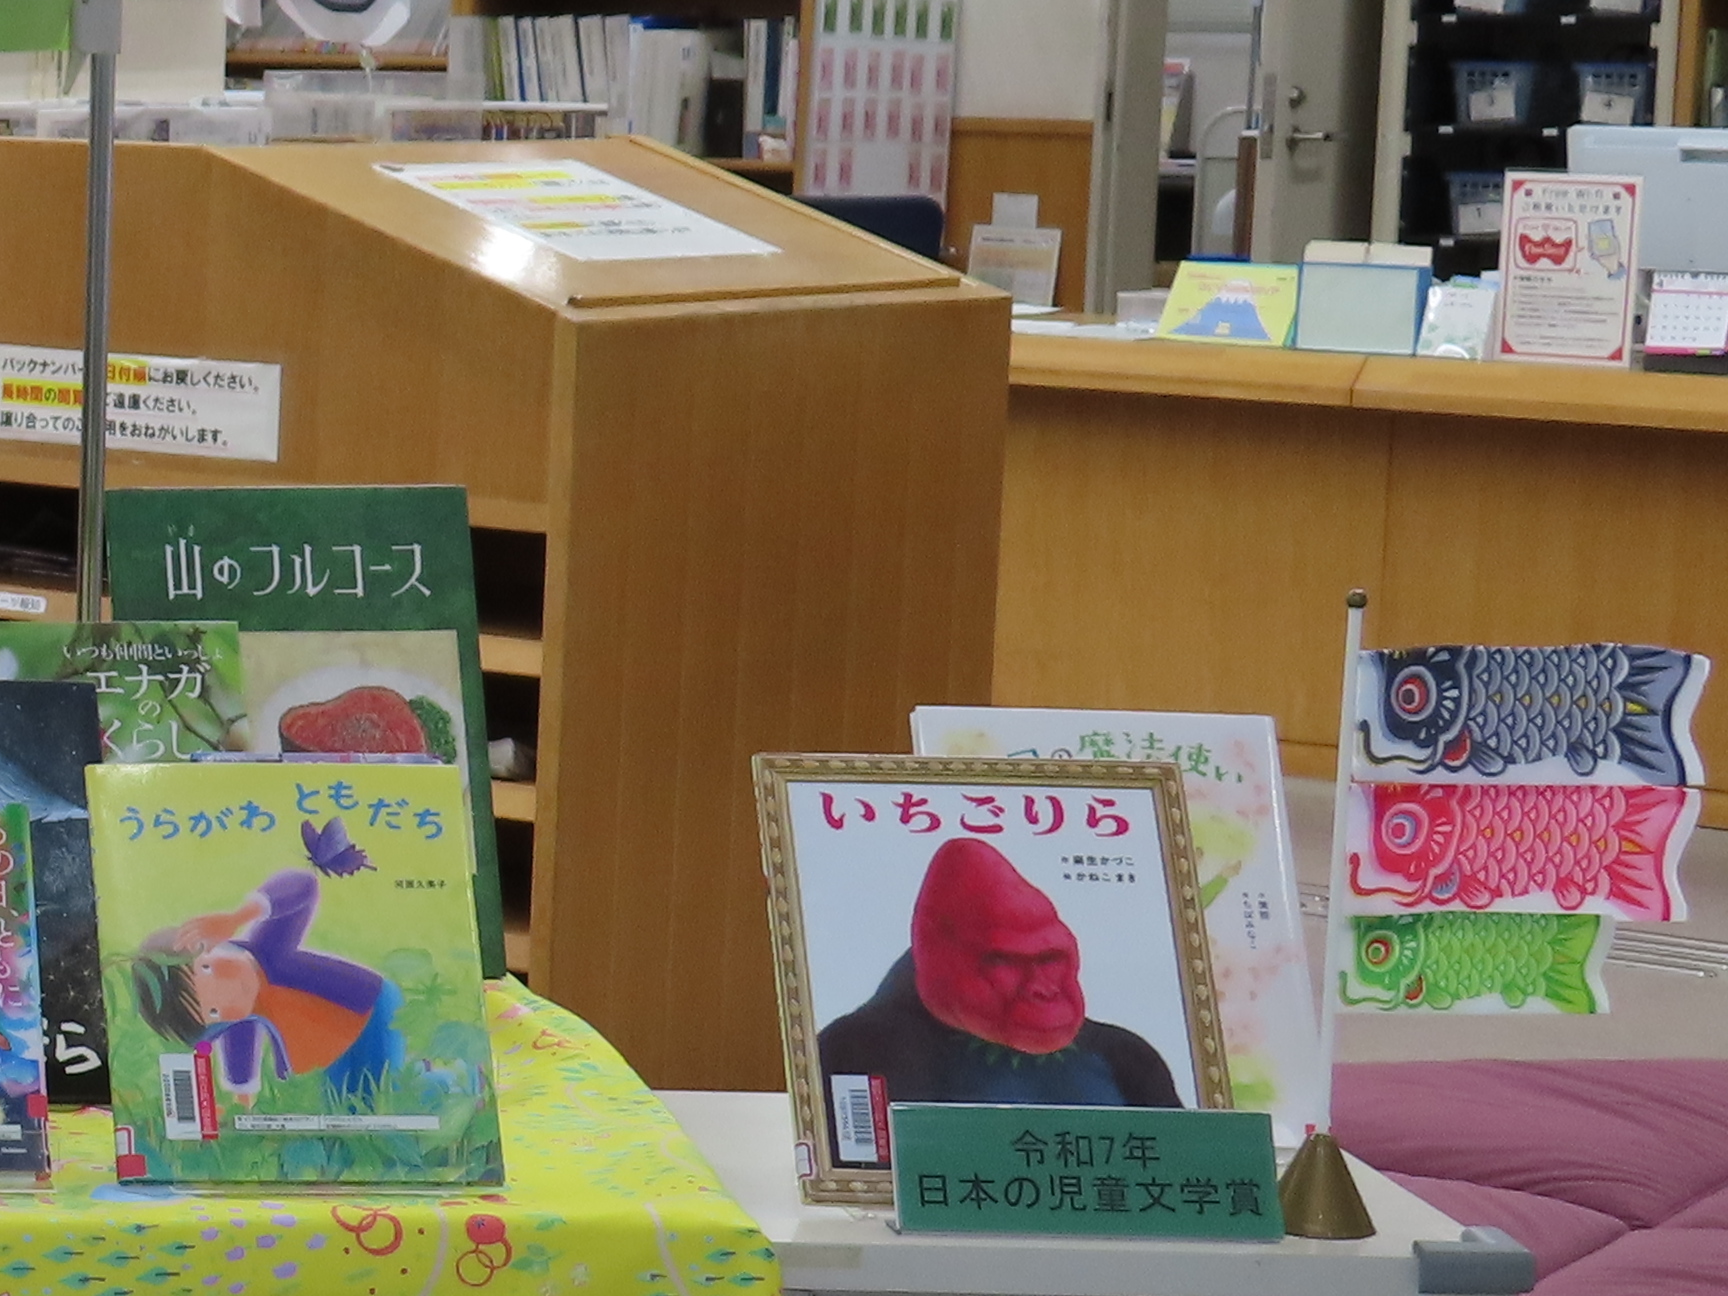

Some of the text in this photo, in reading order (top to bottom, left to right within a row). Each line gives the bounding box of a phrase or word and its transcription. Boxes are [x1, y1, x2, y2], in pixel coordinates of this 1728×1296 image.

[1, 356, 260, 393] バックナンバー日付順にお戻しください。
[163, 537, 434, 603] 山のフルコース
[86, 662, 213, 702] エナガ
[137, 699, 162, 718] の
[100, 718, 200, 763] くらし
[118, 780, 444, 842] うらがわ ともだち
[819, 790, 1131, 838] いちごりら
[1011, 1129, 1161, 1170] 令和7年
[917, 1172, 1266, 1219] 日本の児童文学賞
